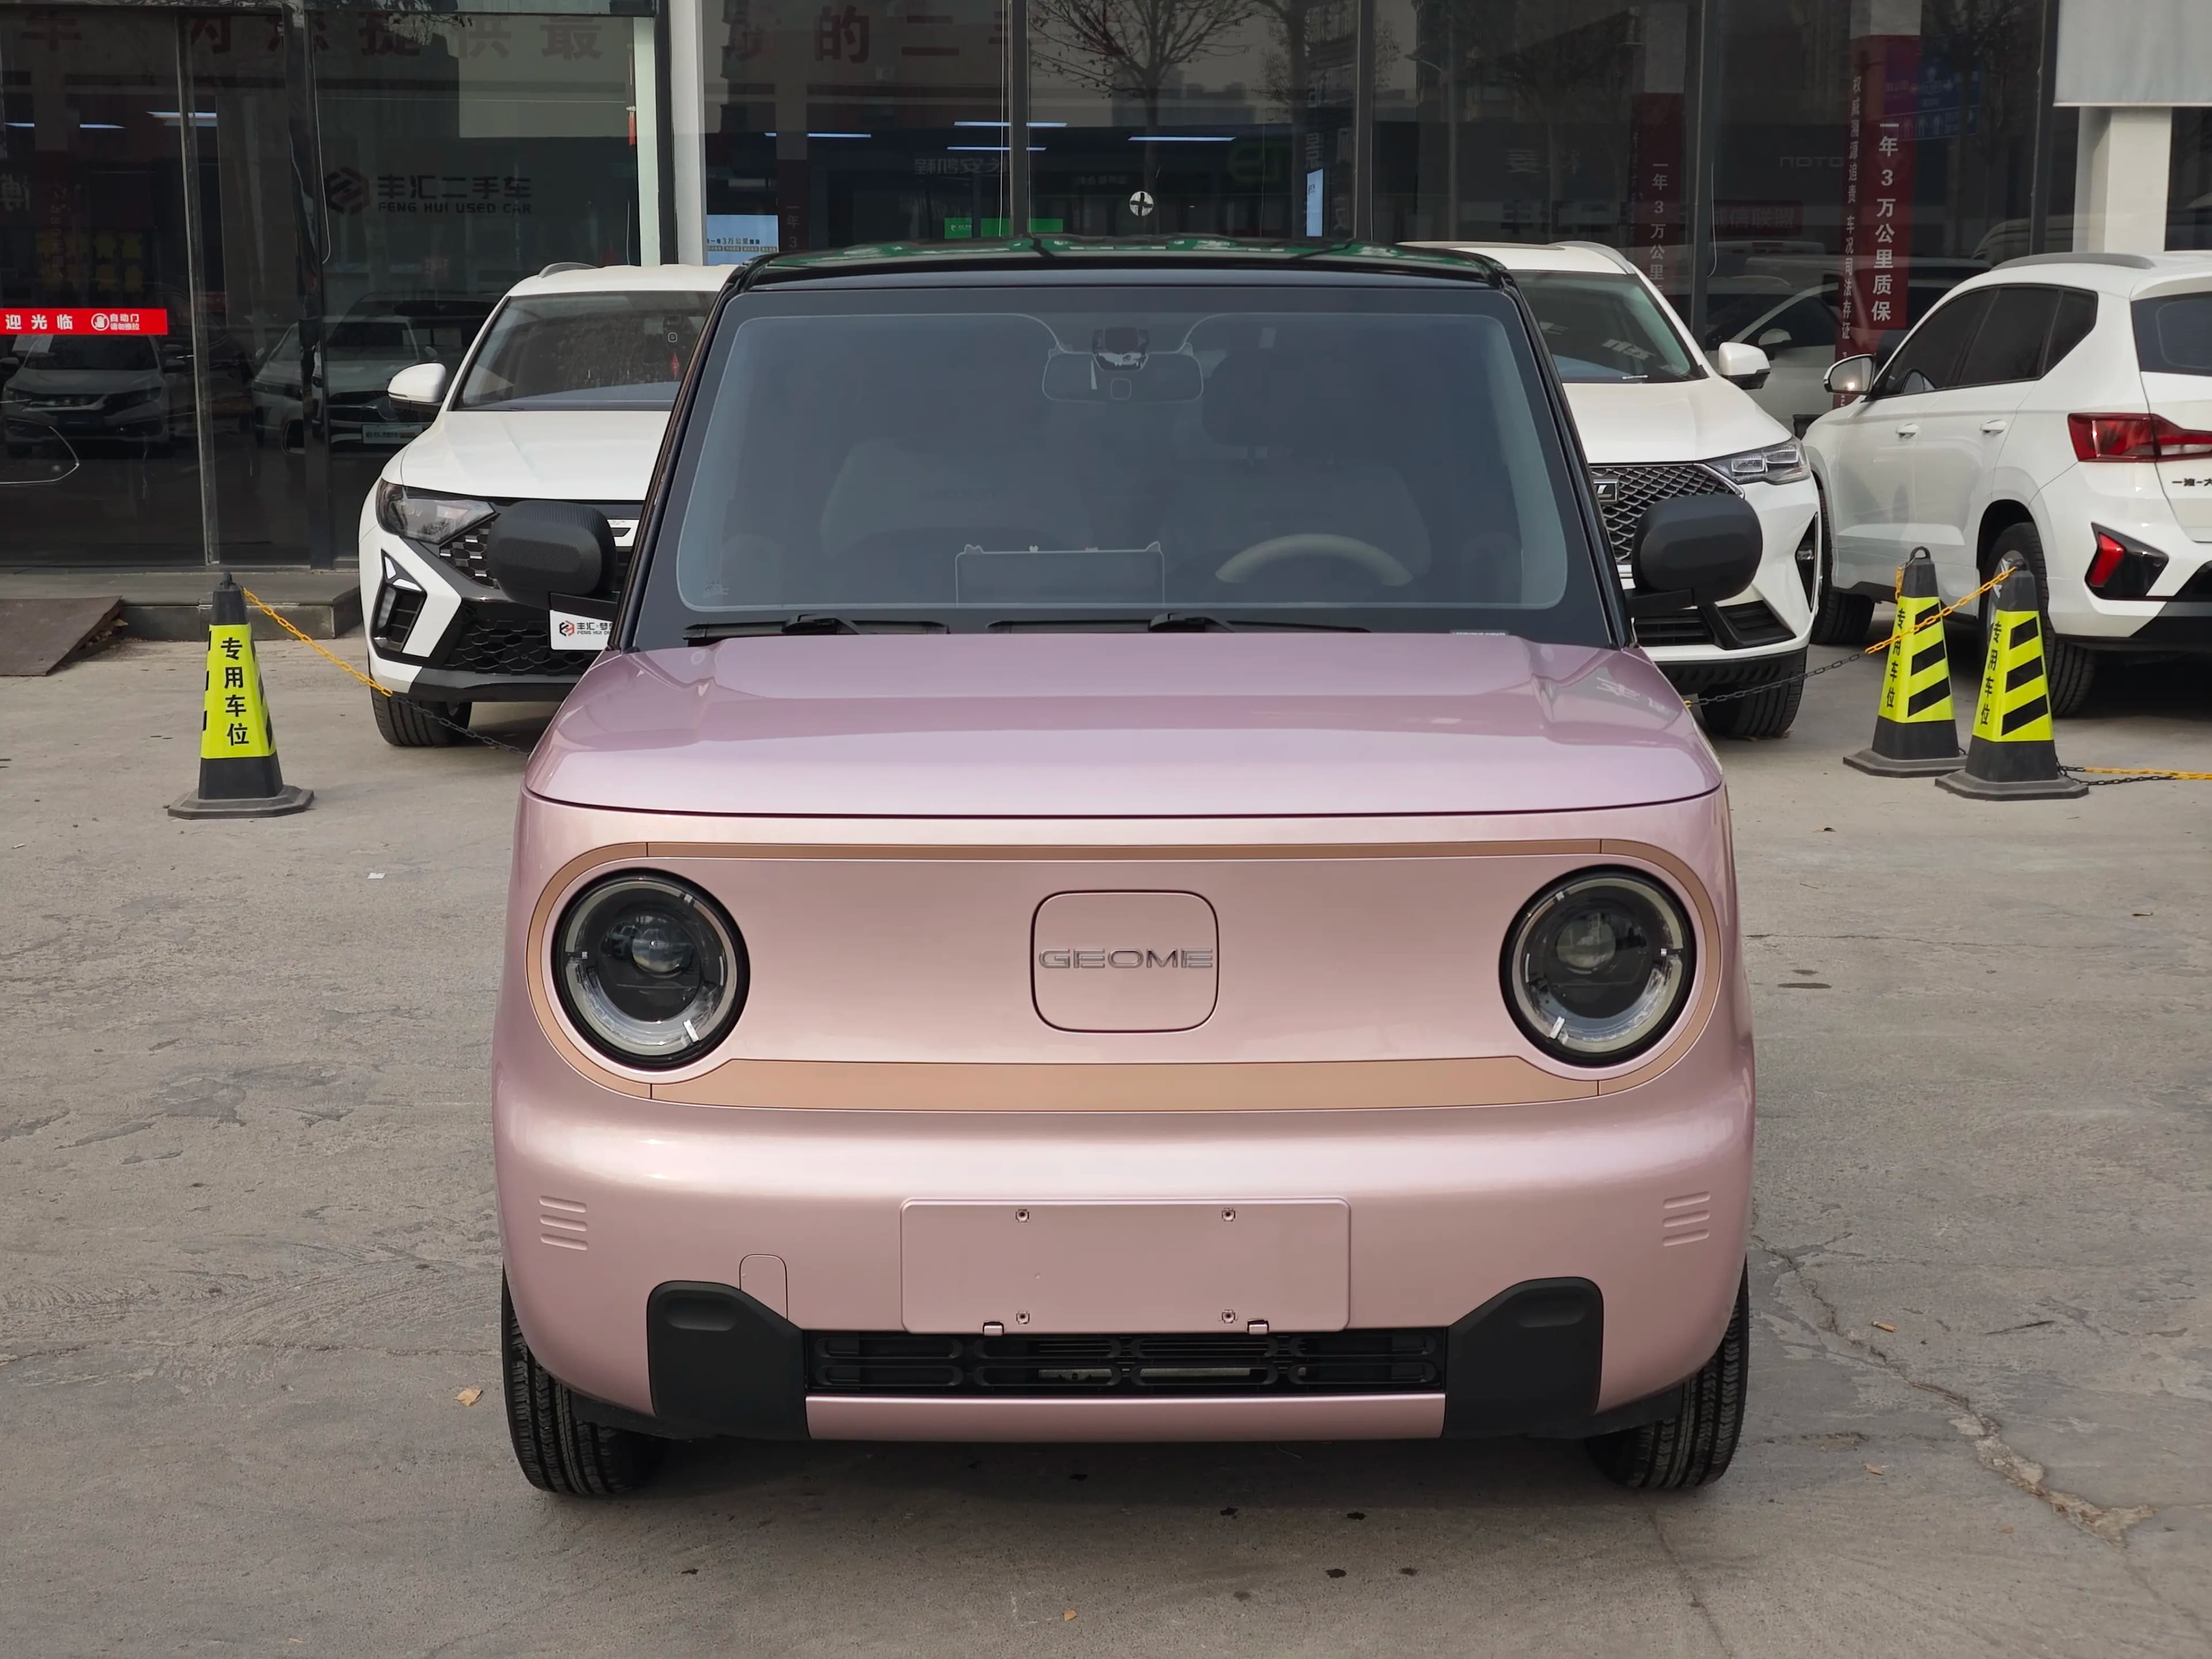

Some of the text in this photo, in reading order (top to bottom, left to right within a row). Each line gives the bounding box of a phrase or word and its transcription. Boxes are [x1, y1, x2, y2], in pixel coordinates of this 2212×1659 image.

[377, 175, 532, 200] 丰汇二手车
[378, 202, 532, 215] FENG HUI USED CAR
[1649, 162, 1669, 291] 一年3万公里
[1871, 122, 1900, 322] 一年3万公里质保
[1841, 214, 1855, 341] 车况司法存证
[5, 314, 74, 330] 迎光临
[109, 313, 140, 322] 自动门
[221, 637, 249, 747] 专用车位
[1980, 620, 2002, 726] 专用车位
[1039, 948, 1213, 969] GEOME
